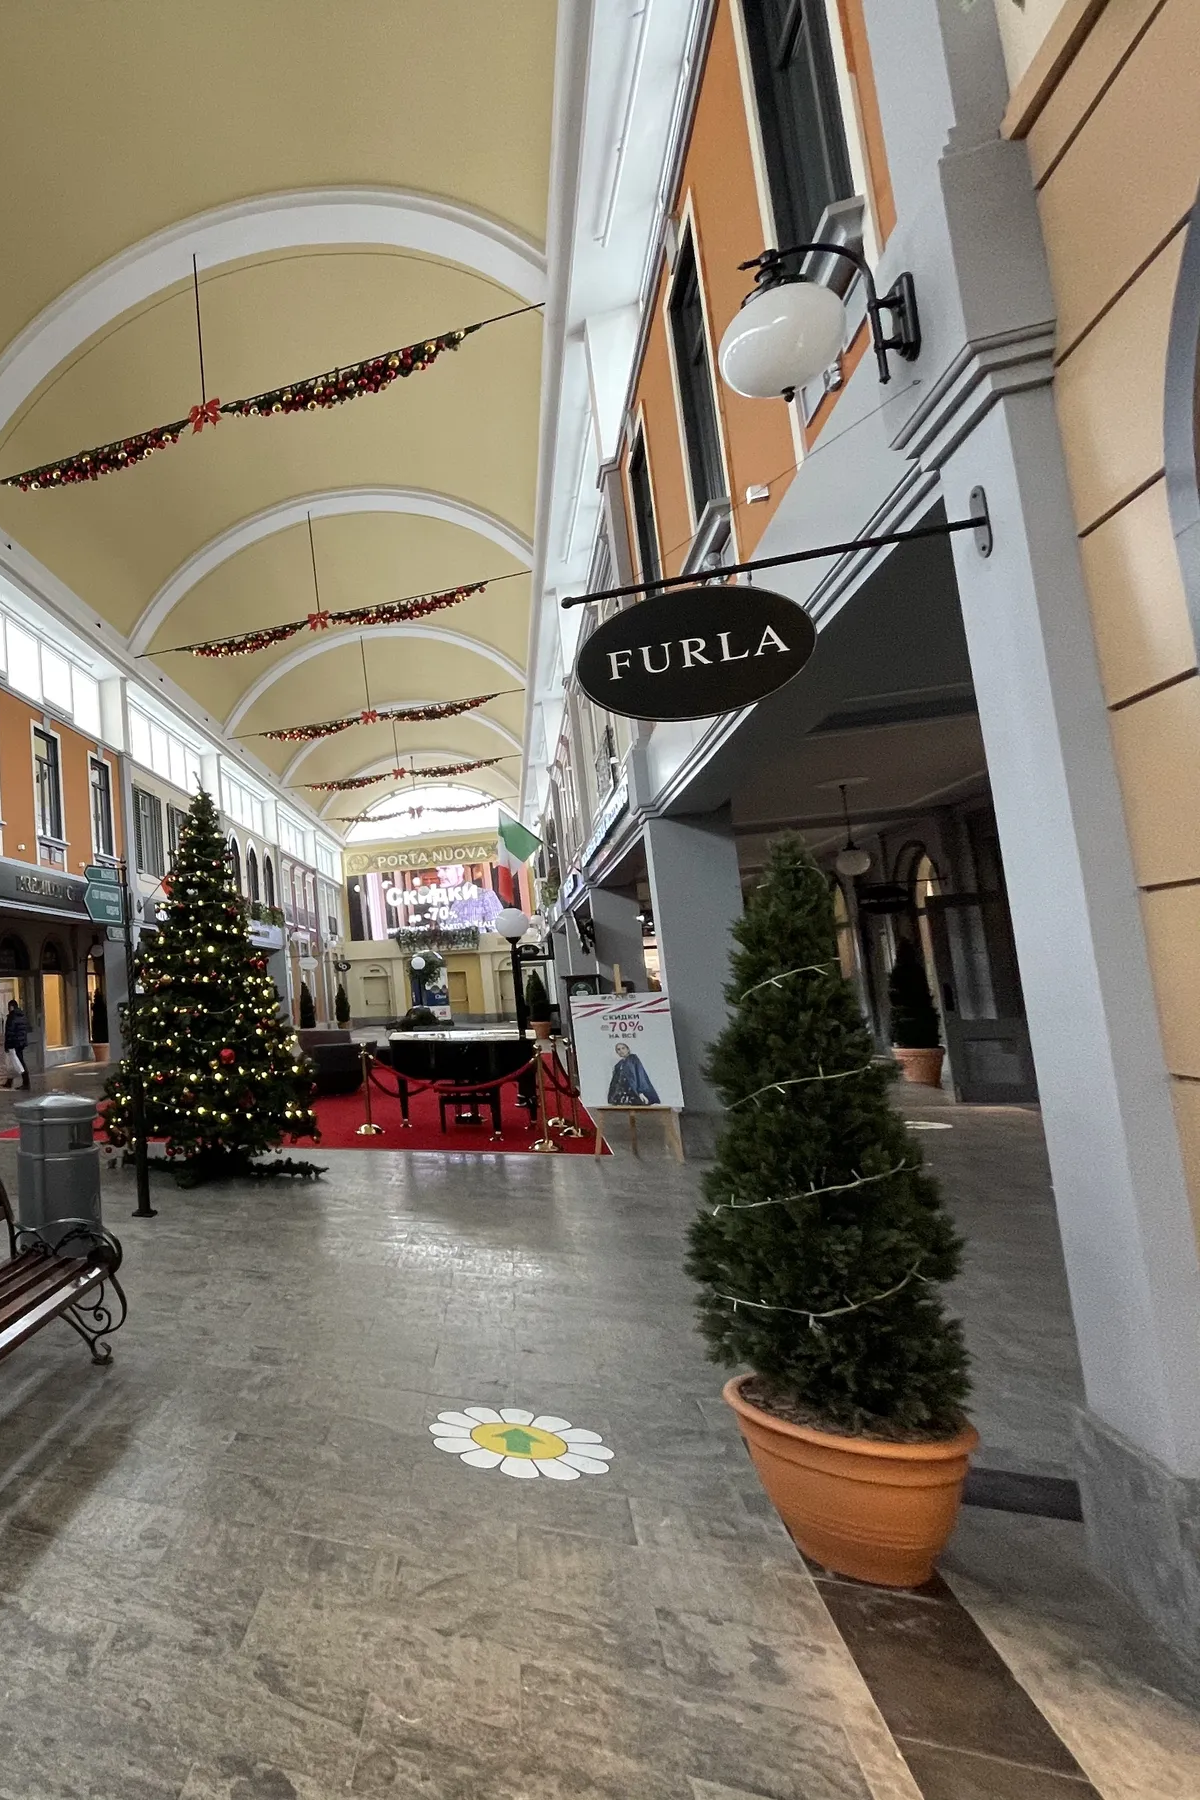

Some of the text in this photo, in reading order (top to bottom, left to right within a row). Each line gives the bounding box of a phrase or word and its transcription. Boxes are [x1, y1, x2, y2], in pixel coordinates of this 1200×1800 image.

[606, 624, 791, 681] FURLA
[376, 846, 488, 868] PORTA NUOVA
[386, 884, 478, 906] Скидки
[602, 1013, 640, 1021] СКИДКИ
